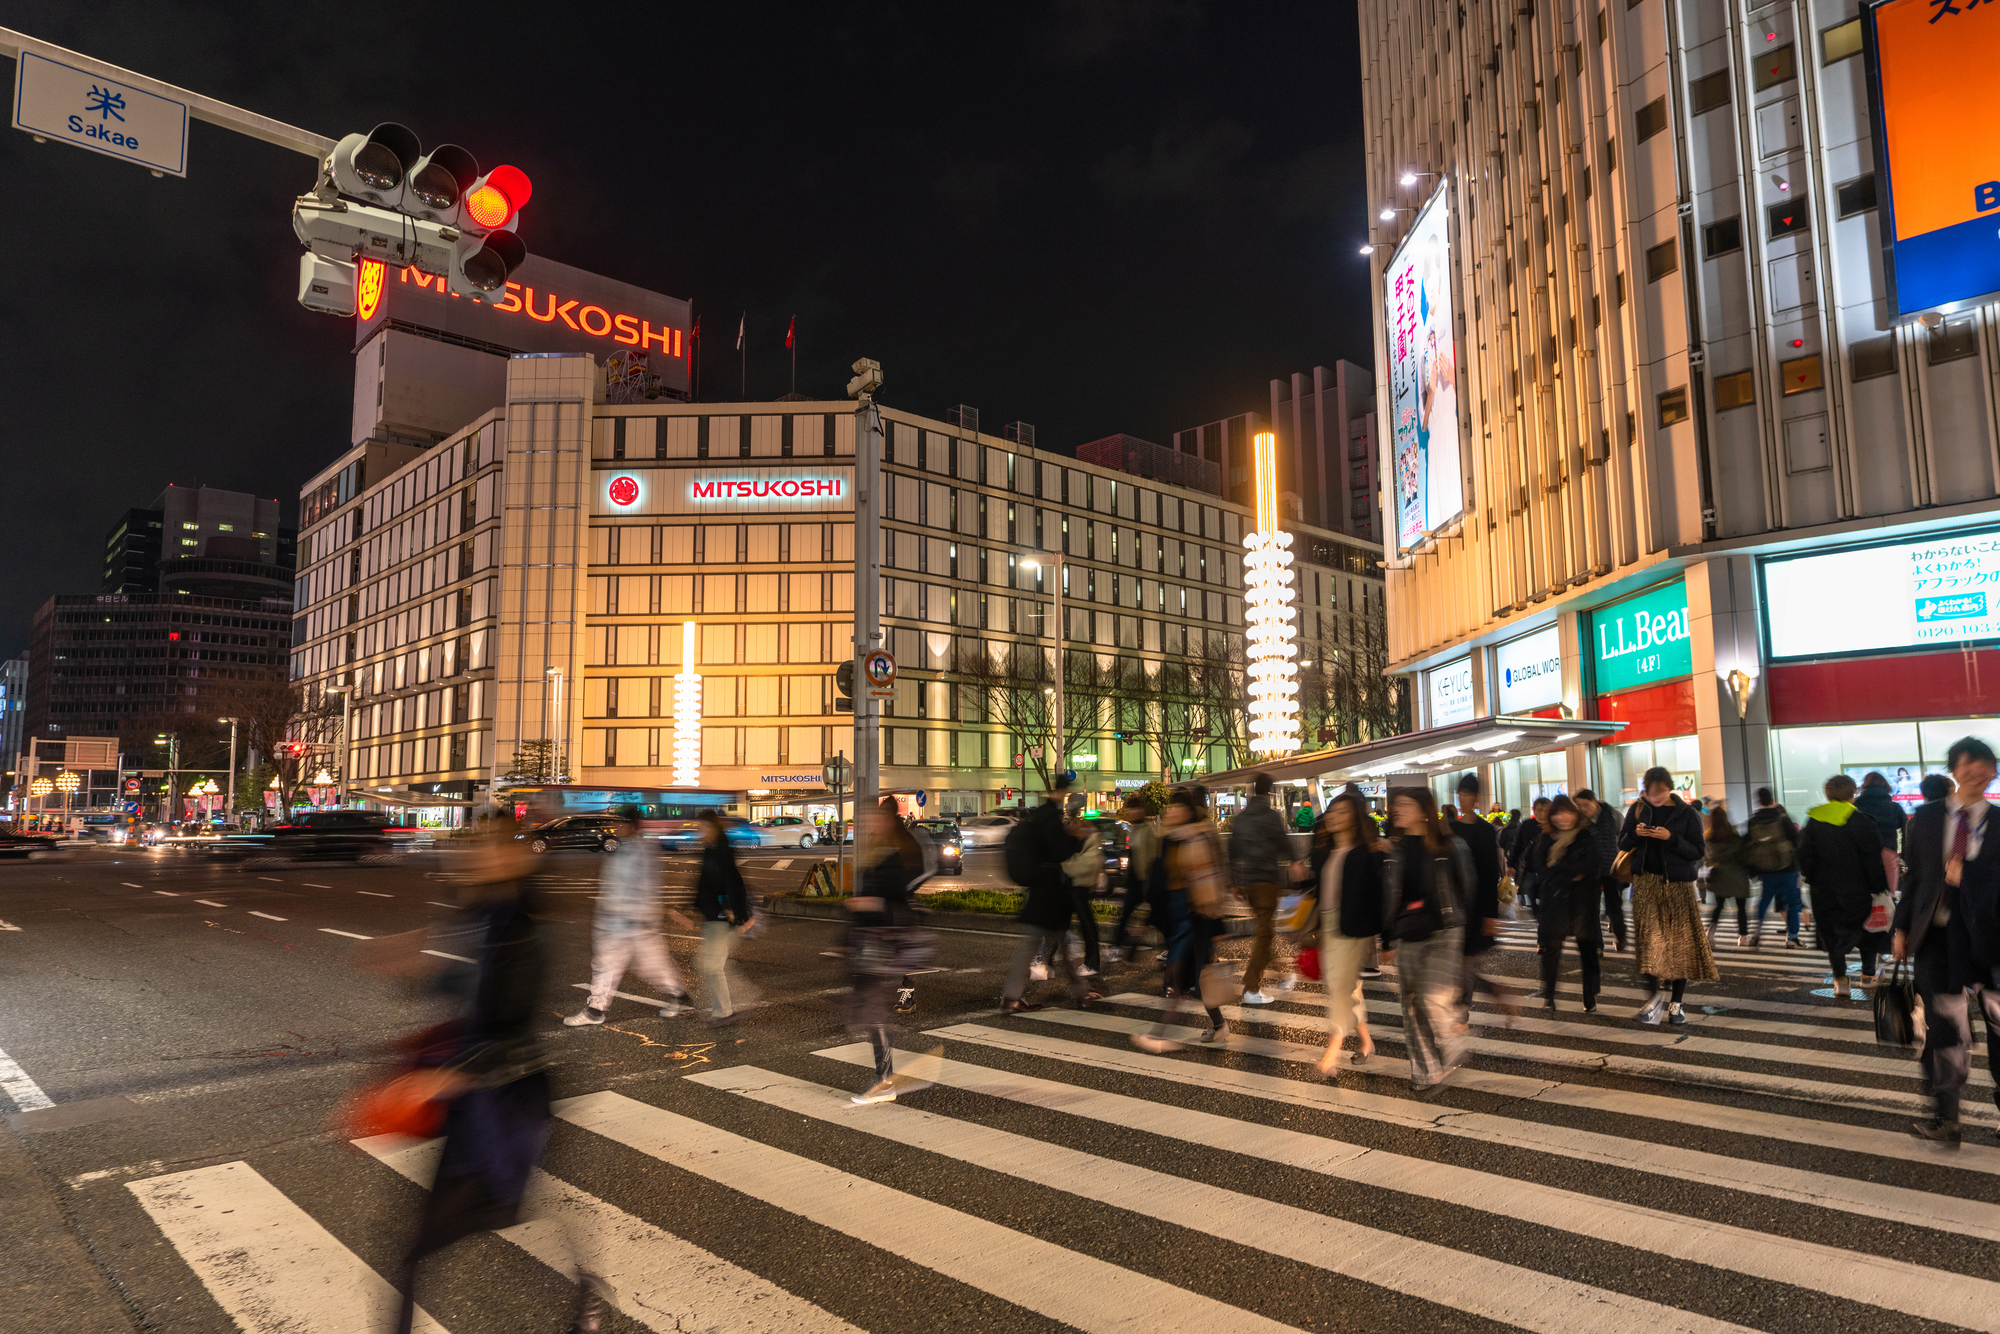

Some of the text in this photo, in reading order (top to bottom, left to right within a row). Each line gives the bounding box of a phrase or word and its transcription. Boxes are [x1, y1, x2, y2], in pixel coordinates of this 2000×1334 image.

[85, 85, 126, 122] 栄
[68, 115, 139, 150] Sakae
[693, 479, 841, 497] MITSUKOSHI
[1912, 558, 1981, 575] よくわかる!
[97, 595, 128, 603] 中日ビル
[1636, 654, 1661, 674] [4F]
[1512, 665, 1541, 682] GLOBAL
[761, 775, 822, 783] MITSUKOSHI
